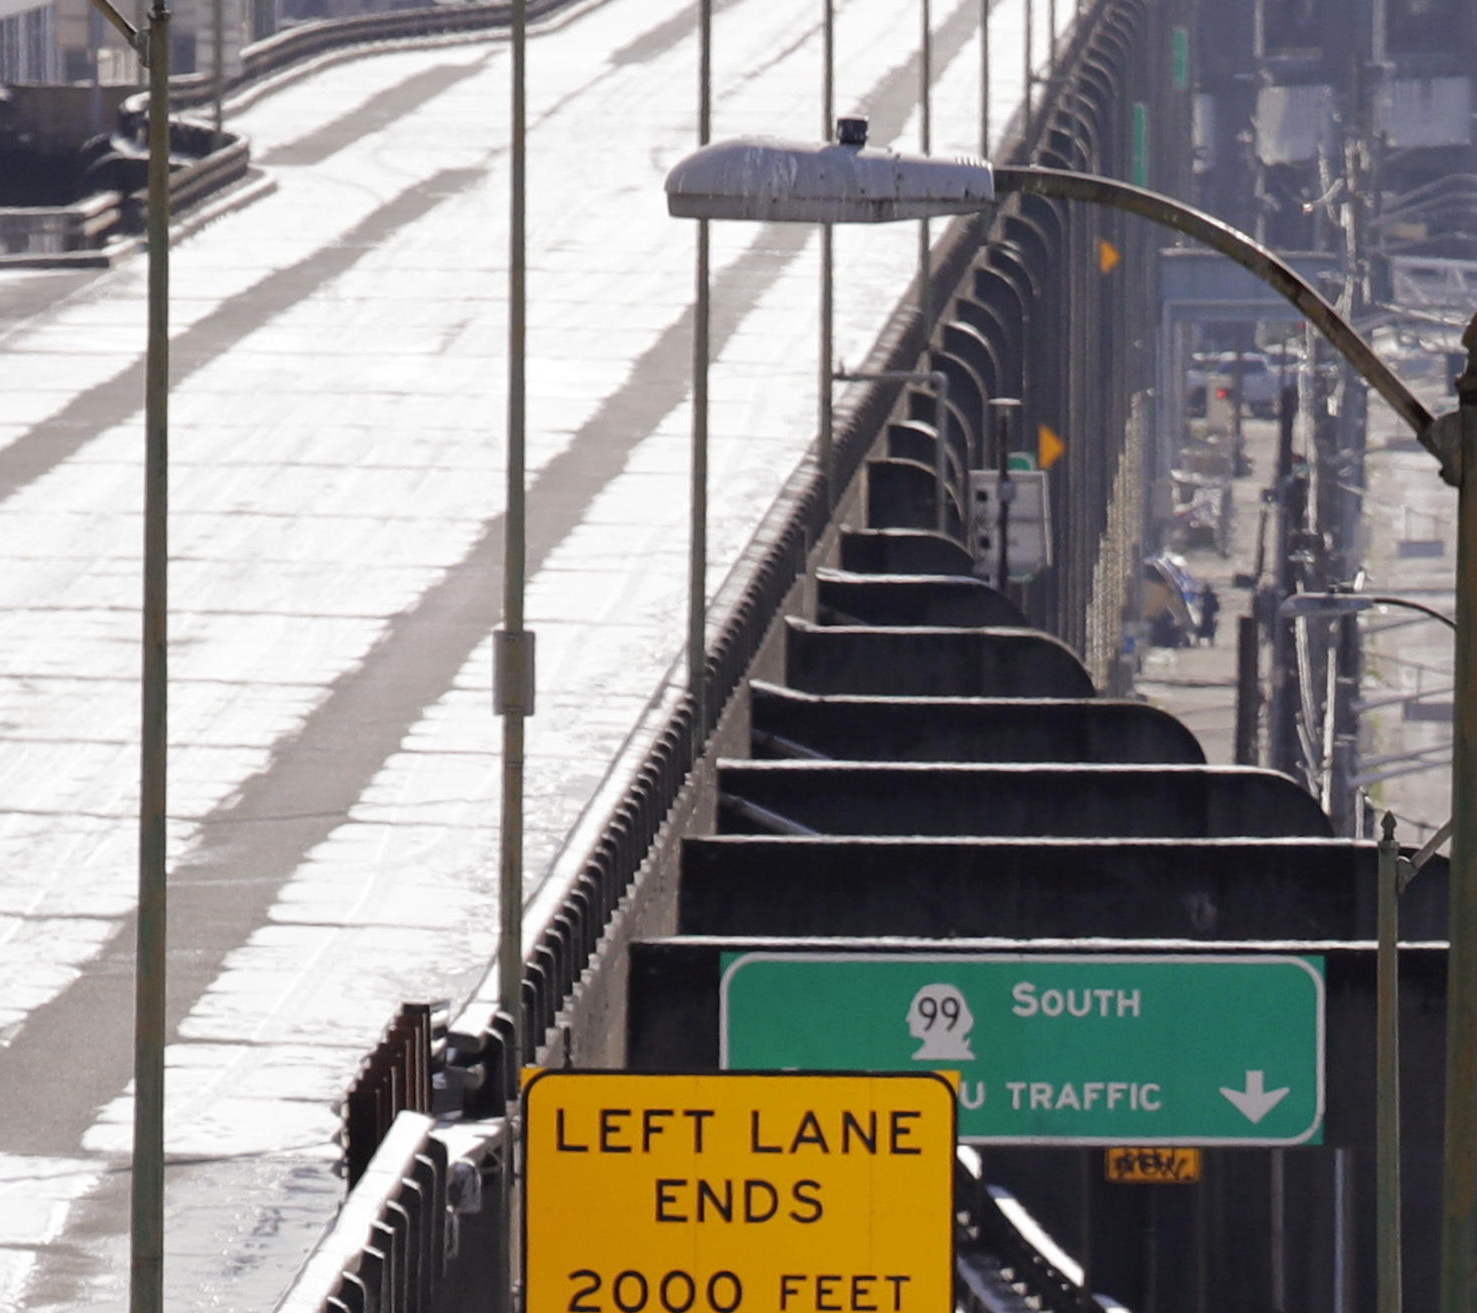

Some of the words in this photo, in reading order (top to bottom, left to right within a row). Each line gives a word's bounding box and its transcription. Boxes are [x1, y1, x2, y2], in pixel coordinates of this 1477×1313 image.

[918, 995, 961, 1033] 99
[1010, 981, 1142, 1019] SOUTH
[1005, 1081, 1162, 1113] TRAFFIC
[556, 1108, 717, 1154] LEFT
[751, 1110, 923, 1156] LANE
[655, 1178, 823, 1225] ENDS
[780, 1274, 912, 1313] FEET
